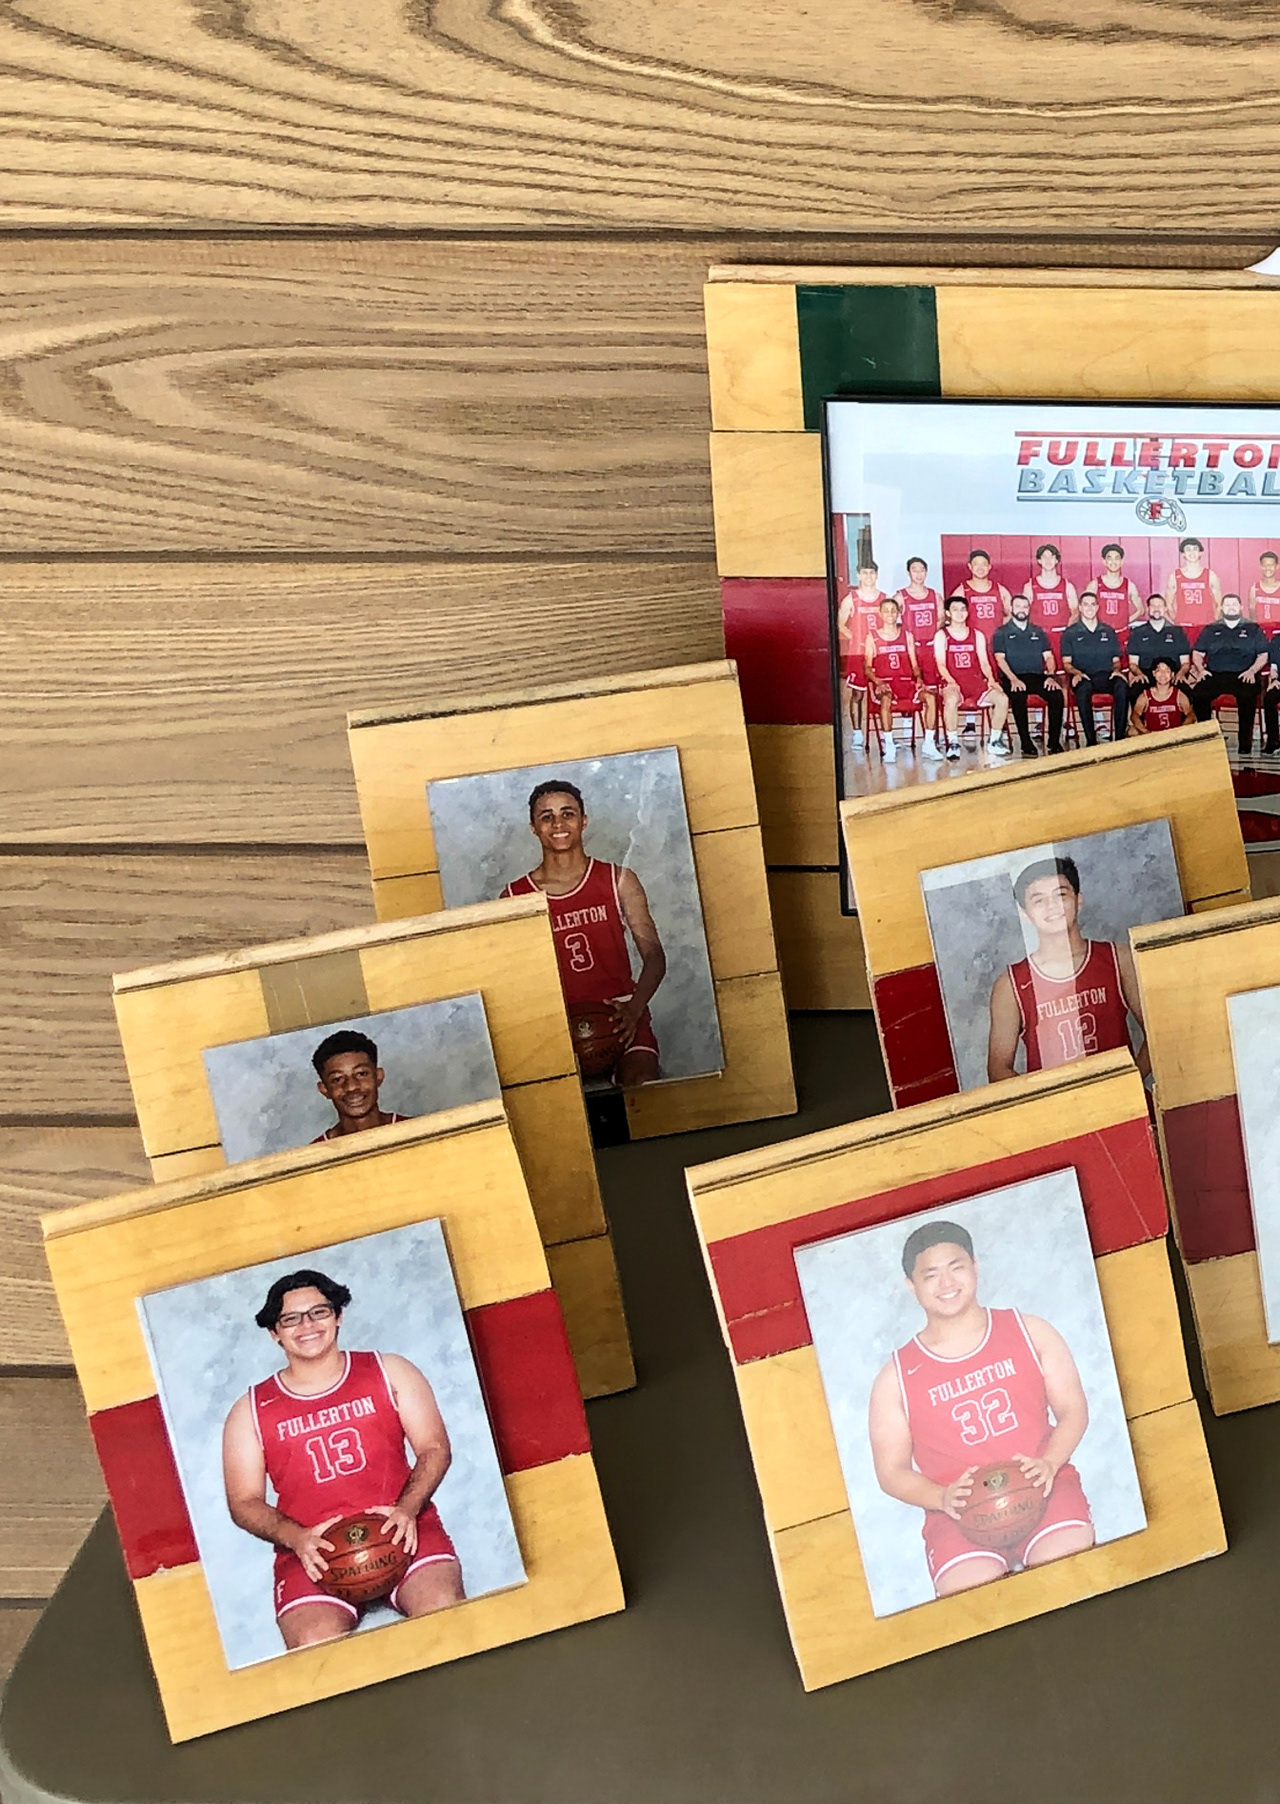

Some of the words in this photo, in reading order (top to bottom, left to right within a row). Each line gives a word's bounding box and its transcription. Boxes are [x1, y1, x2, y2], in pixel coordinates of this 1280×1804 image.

[552, 905, 608, 933] LLERTON
[565, 932, 594, 973] 3
[1036, 987, 1107, 1021] FULLERTON
[1057, 1012, 1098, 1061] 12
[927, 1357, 1017, 1407] FULLERTON
[276, 1394, 377, 1442] FULLERTON
[952, 1387, 1019, 1447] 32
[306, 1428, 367, 1484] 13
